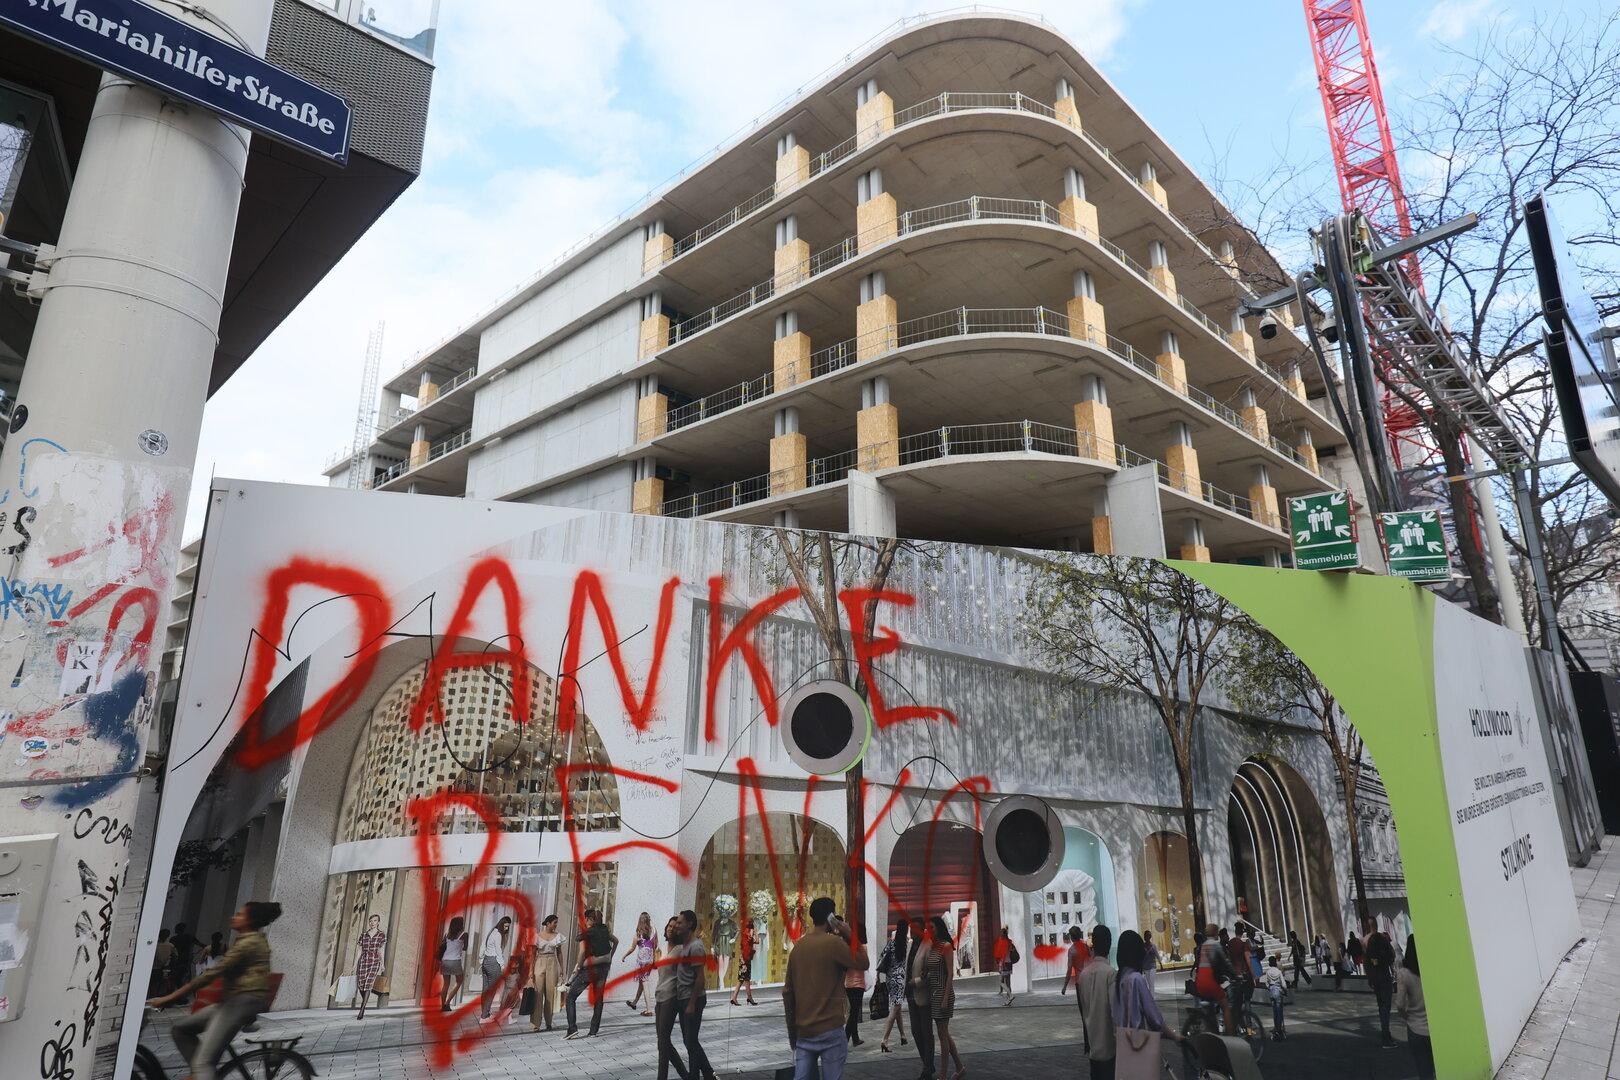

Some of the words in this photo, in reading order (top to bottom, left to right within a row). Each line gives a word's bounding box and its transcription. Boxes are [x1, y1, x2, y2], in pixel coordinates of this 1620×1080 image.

[40, 0, 243, 92] Mariahilfer
[242, 76, 336, 136] Straße
[1297, 553, 1358, 567] Sammelplatz
[1391, 567, 1450, 577] Sammelplatz
[234, 556, 959, 771] DANKE
[1468, 708, 1512, 738] HOLLYWOOD
[1500, 833, 1535, 882] STILIKONE
[407, 757, 992, 1071] BENKO
